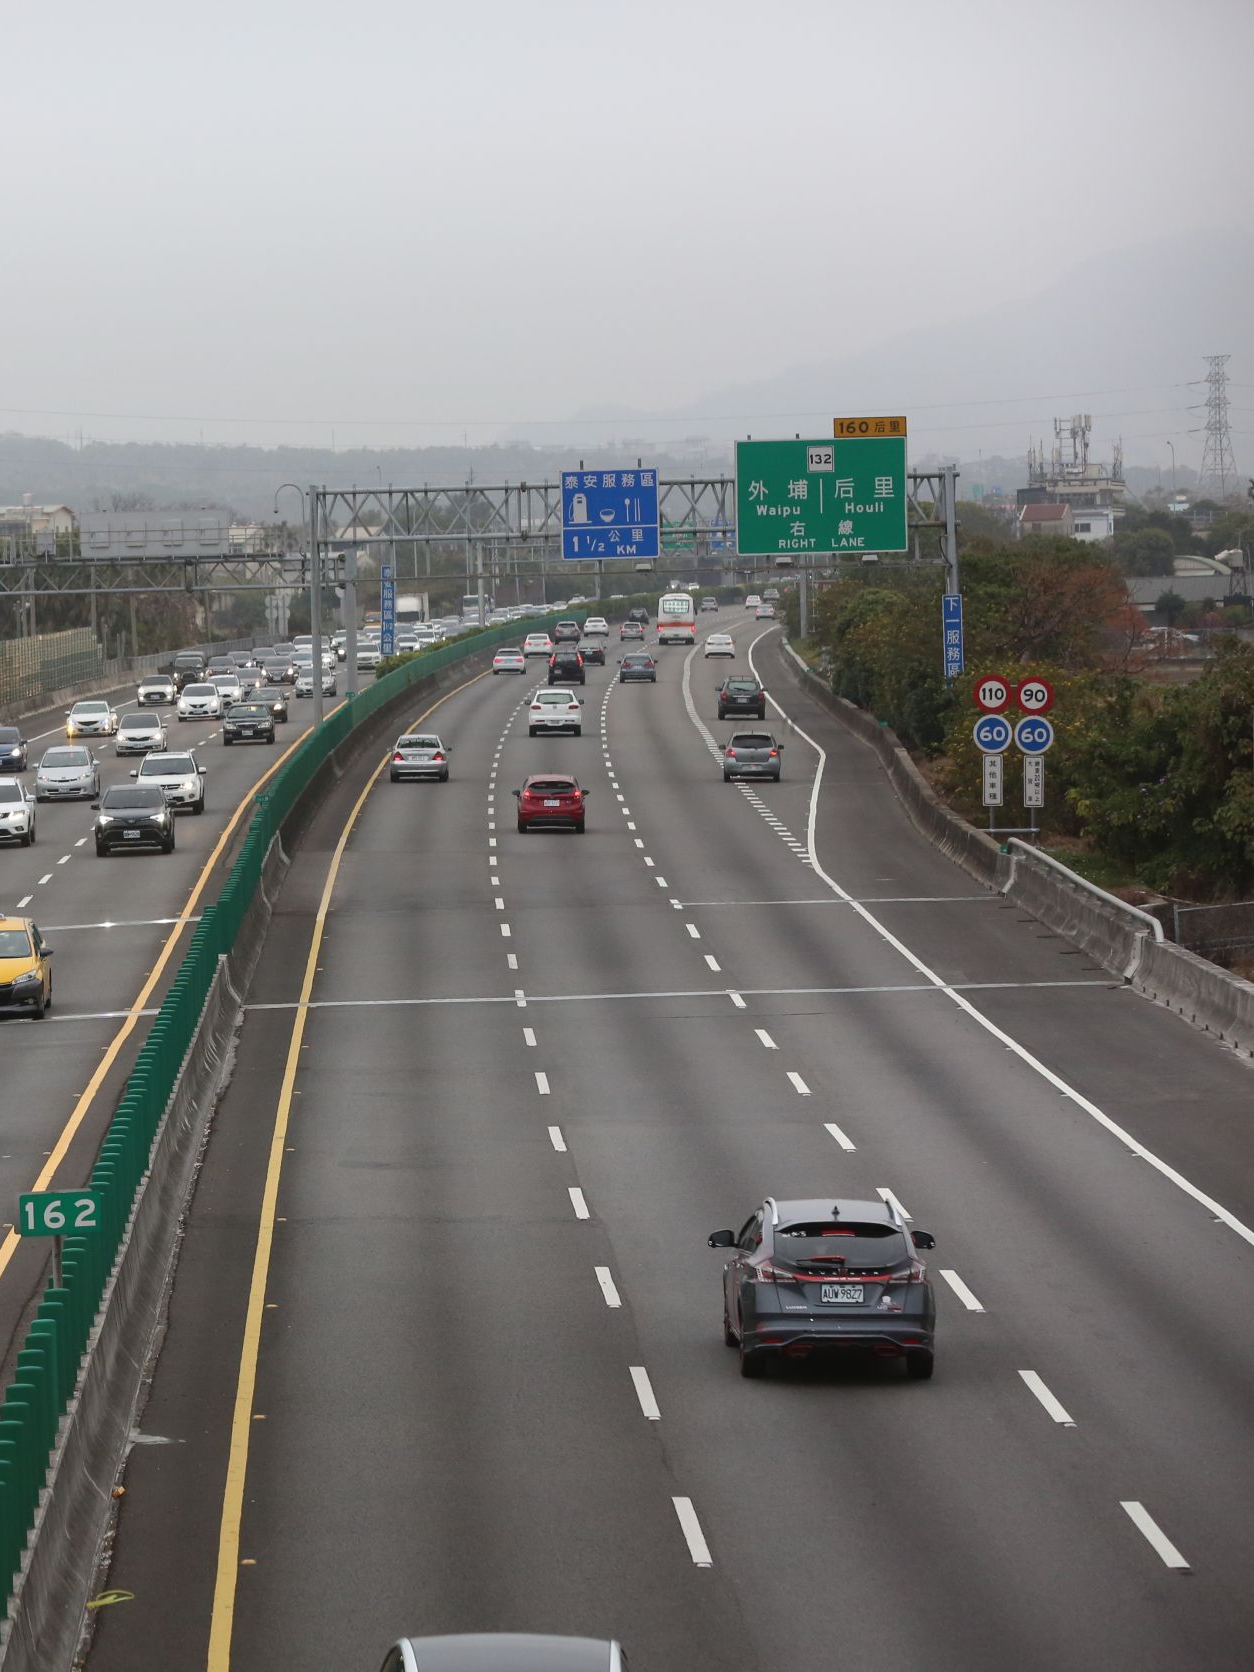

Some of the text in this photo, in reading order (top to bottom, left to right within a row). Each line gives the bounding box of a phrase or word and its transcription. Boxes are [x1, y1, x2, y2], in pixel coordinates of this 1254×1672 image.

[838, 420, 901, 434] 160 后里
[809, 454, 832, 465] 132
[565, 472, 654, 489] 泰安服務區
[748, 476, 895, 501] 外埔 后里
[756, 502, 884, 518] Waipu Houli
[608, 529, 644, 542] 公里
[790, 519, 855, 537] 右線
[617, 545, 637, 555] KM
[778, 537, 866, 549] RIGHT LANE
[945, 596, 961, 678] 下一服務區
[981, 687, 1004, 700] 110
[1023, 688, 1046, 703] 90
[979, 726, 1006, 742] 60
[1021, 727, 1047, 743] 60
[25, 1199, 96, 1230] 162
